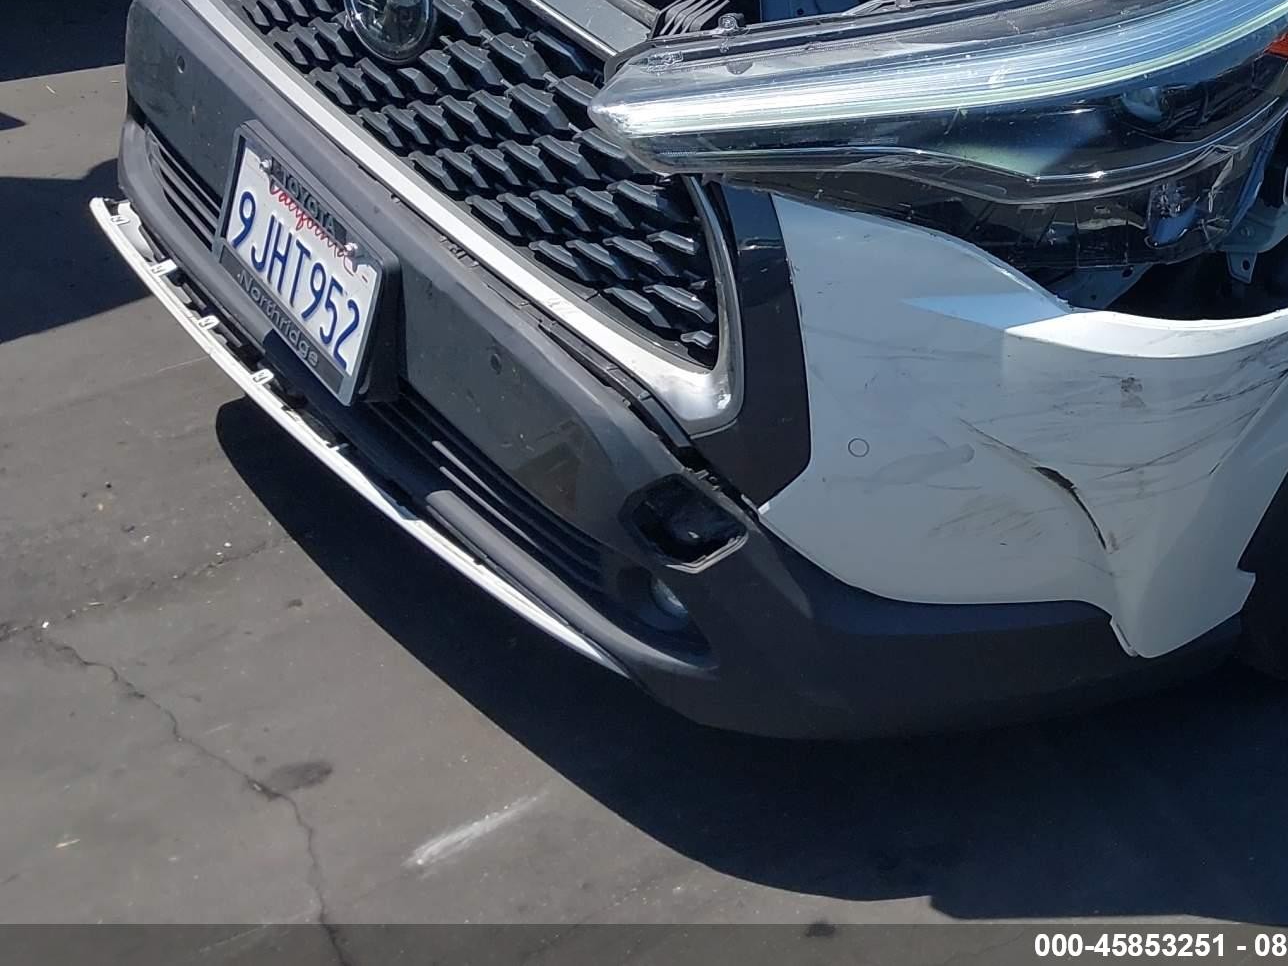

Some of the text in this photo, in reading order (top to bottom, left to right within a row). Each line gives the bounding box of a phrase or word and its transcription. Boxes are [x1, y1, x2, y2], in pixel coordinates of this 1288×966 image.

[282, 166, 338, 232] TOYOTA
[232, 191, 360, 370] 9JHT952
[240, 271, 320, 367] Northridge
